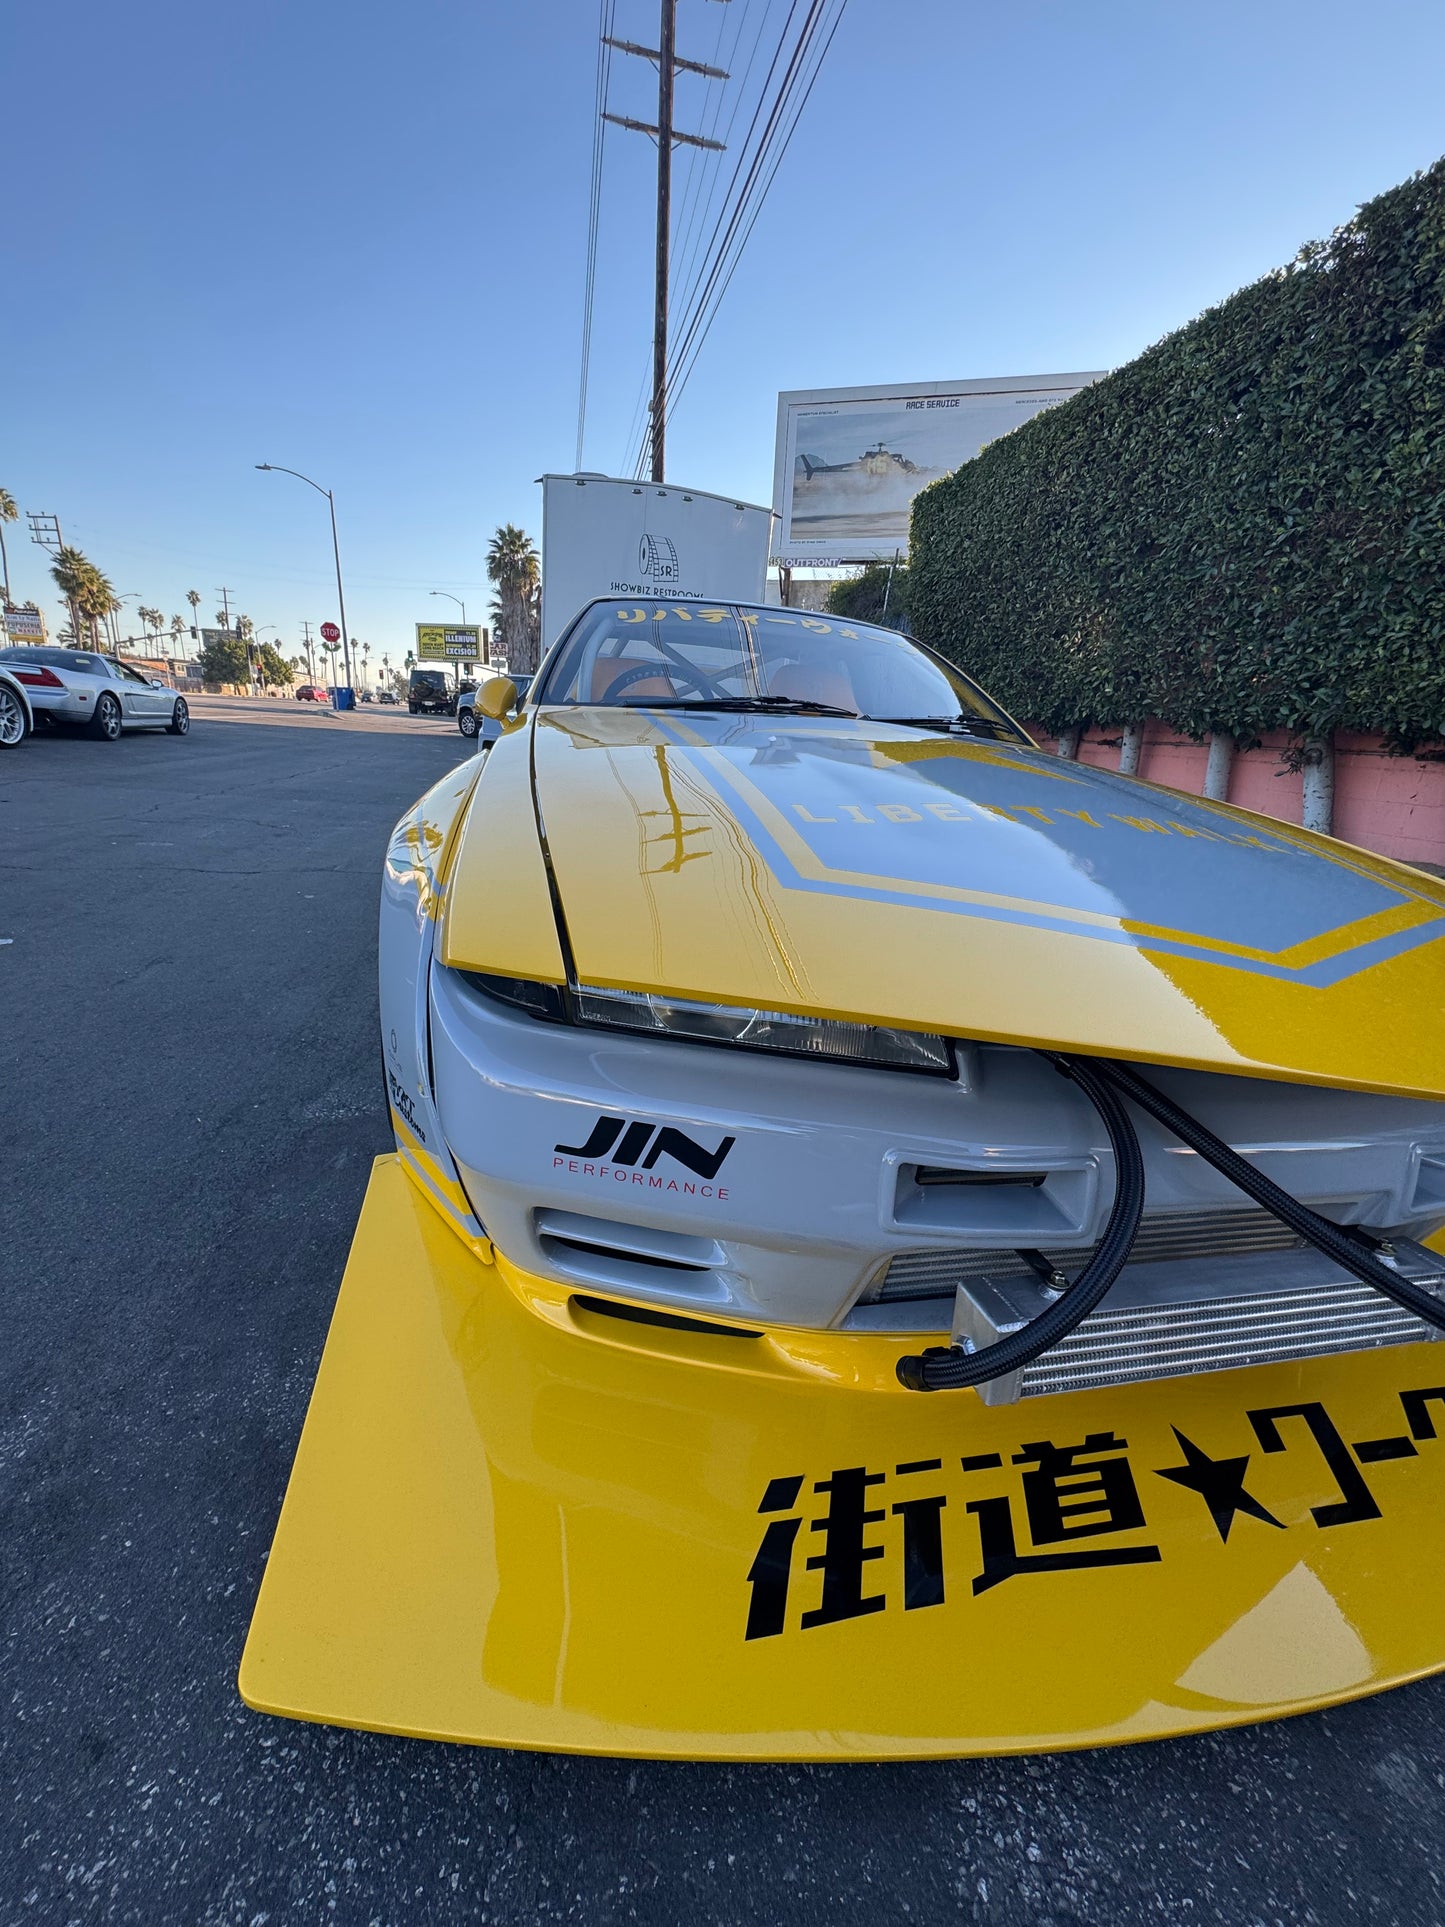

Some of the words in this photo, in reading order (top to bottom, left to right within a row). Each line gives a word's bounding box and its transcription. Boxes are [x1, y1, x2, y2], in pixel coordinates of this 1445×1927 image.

[906, 401, 925, 410] RACE
[926, 399, 960, 409] SERVICE
[660, 565, 673, 577] SR
[610, 581, 651, 596] SHOWBIZ
[321, 627, 339, 636] STOP
[445, 647, 477, 656] EXCISION
[791, 803, 1104, 829] LIBERTY
[553, 1116, 736, 1180] JIN
[553, 1157, 729, 1200] PERFORMANCE
